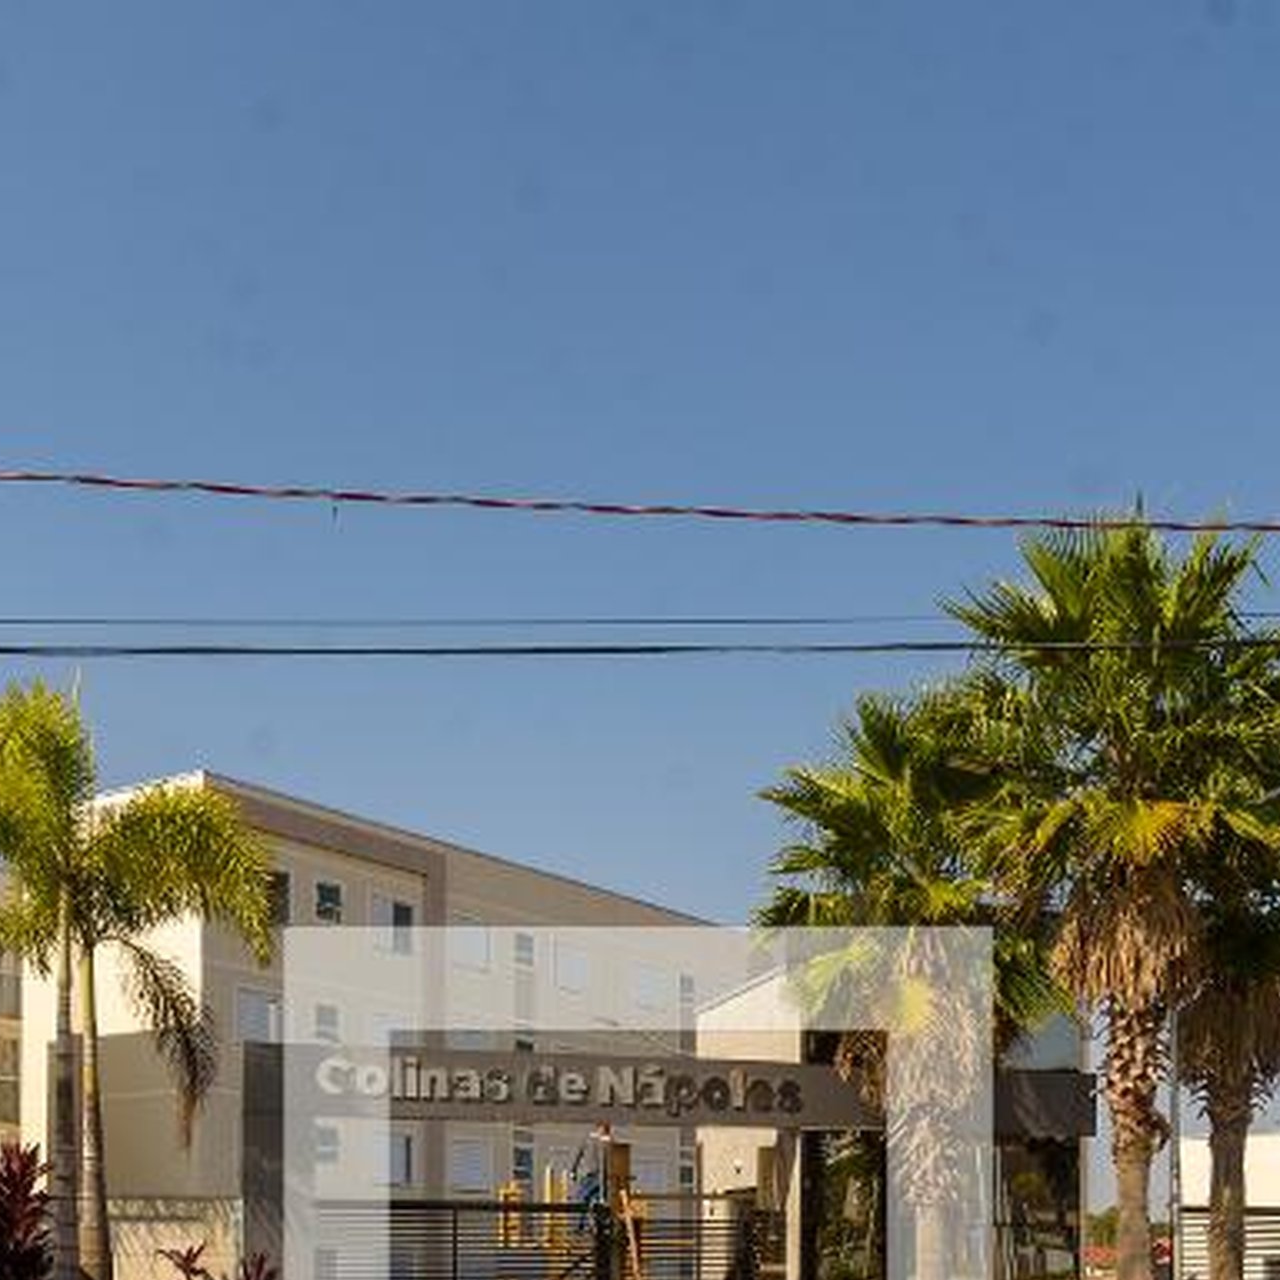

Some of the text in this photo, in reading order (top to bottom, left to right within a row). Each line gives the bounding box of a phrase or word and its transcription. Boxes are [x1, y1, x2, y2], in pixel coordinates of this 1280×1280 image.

[315, 1056, 803, 1117] Colinas de Nápoles
